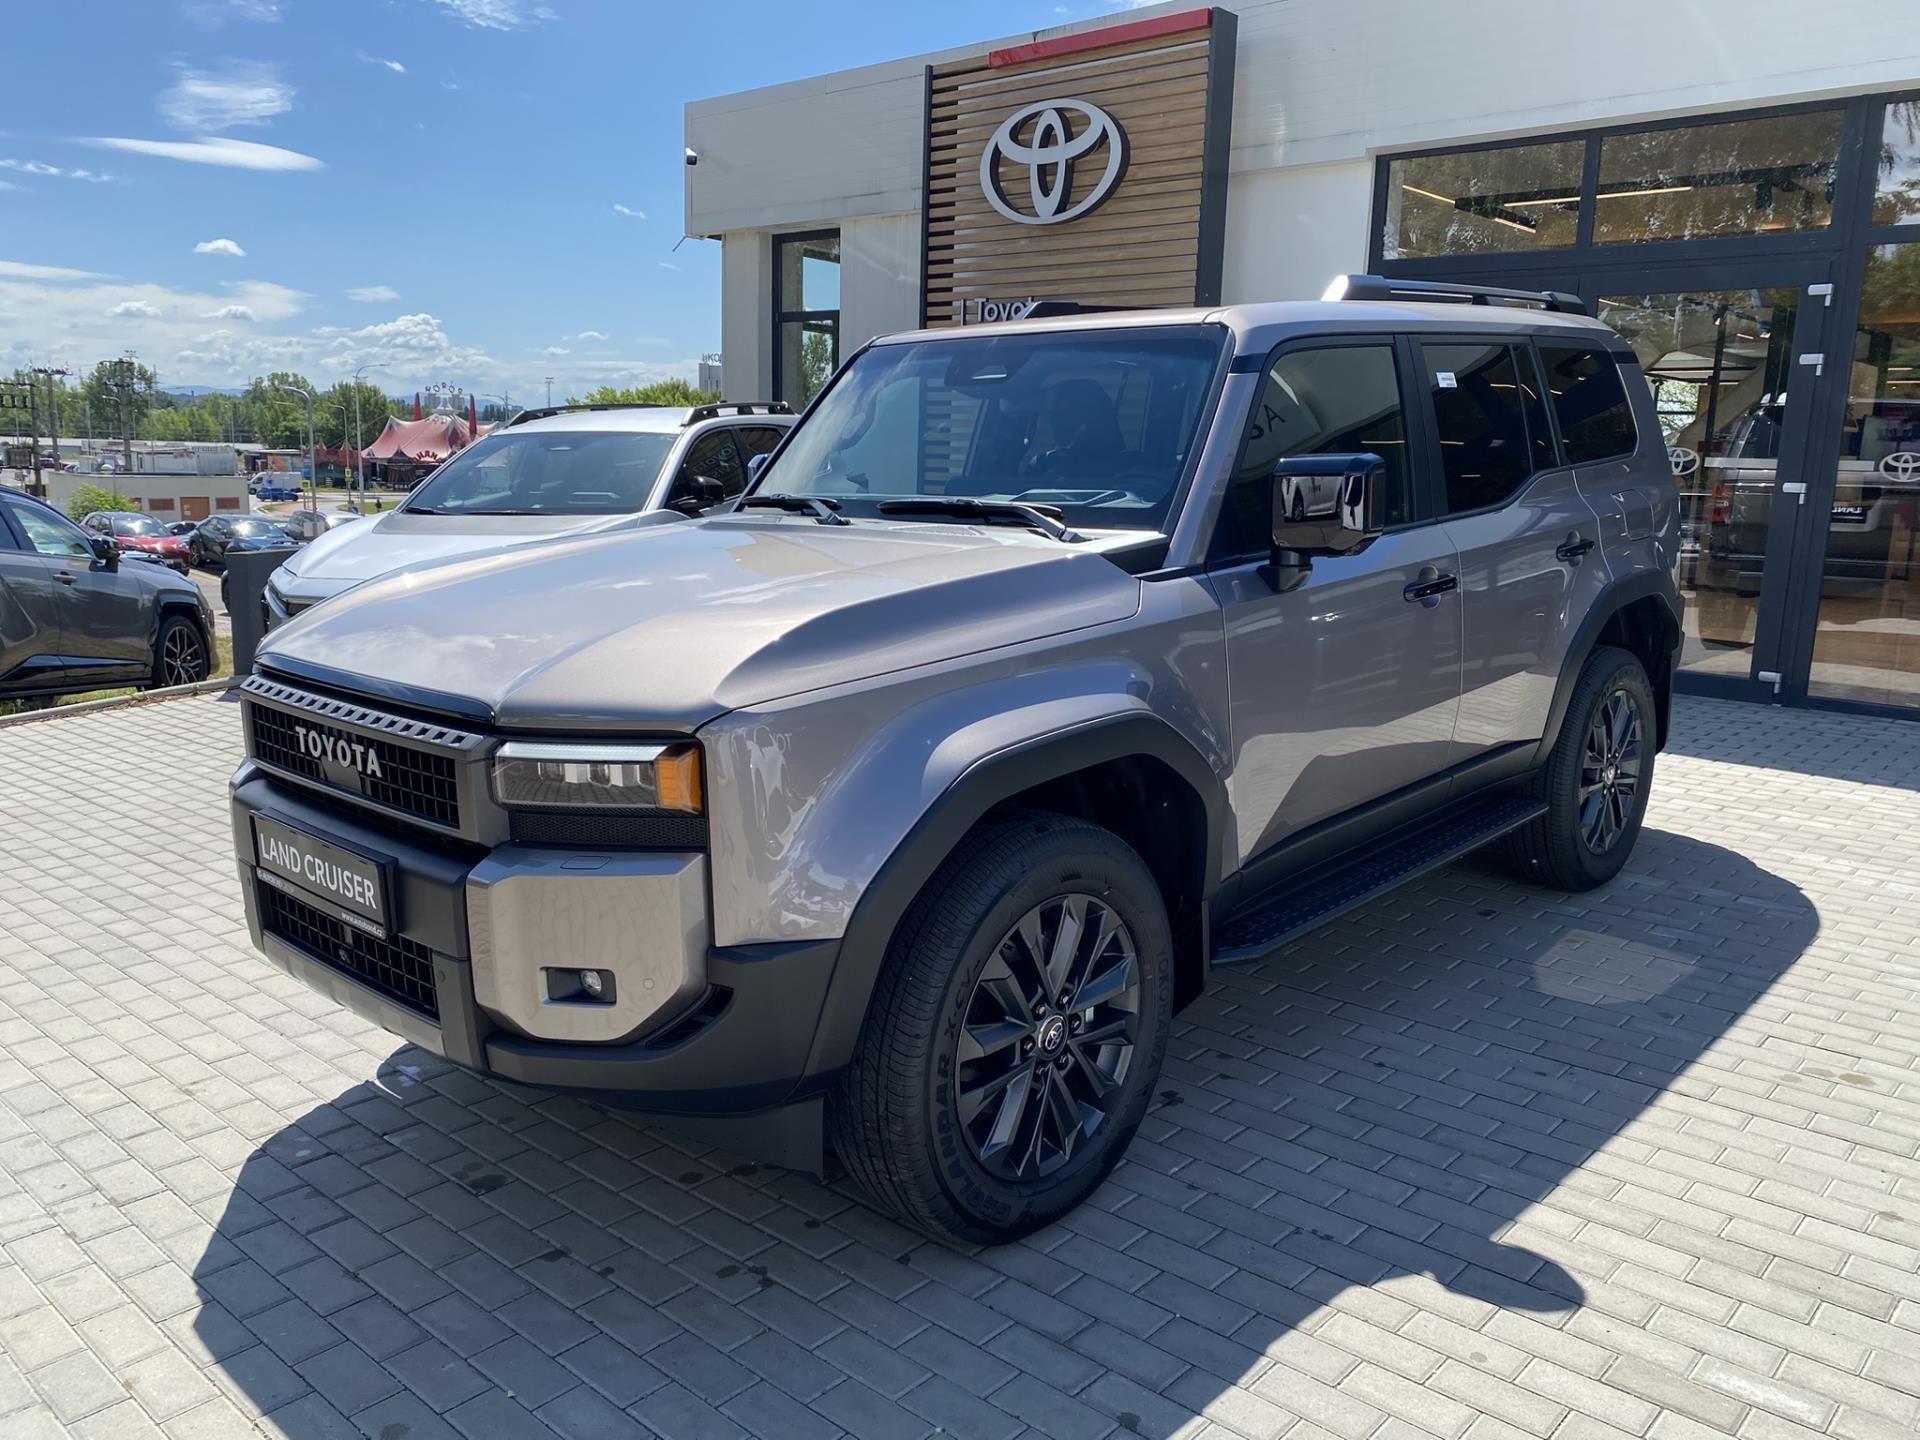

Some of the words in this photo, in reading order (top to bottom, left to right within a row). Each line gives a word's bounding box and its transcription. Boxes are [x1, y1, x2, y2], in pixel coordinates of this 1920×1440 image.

[295, 725, 383, 778] TOYOTA
[259, 832, 302, 875] LAND
[304, 853, 377, 909] CRUISER
